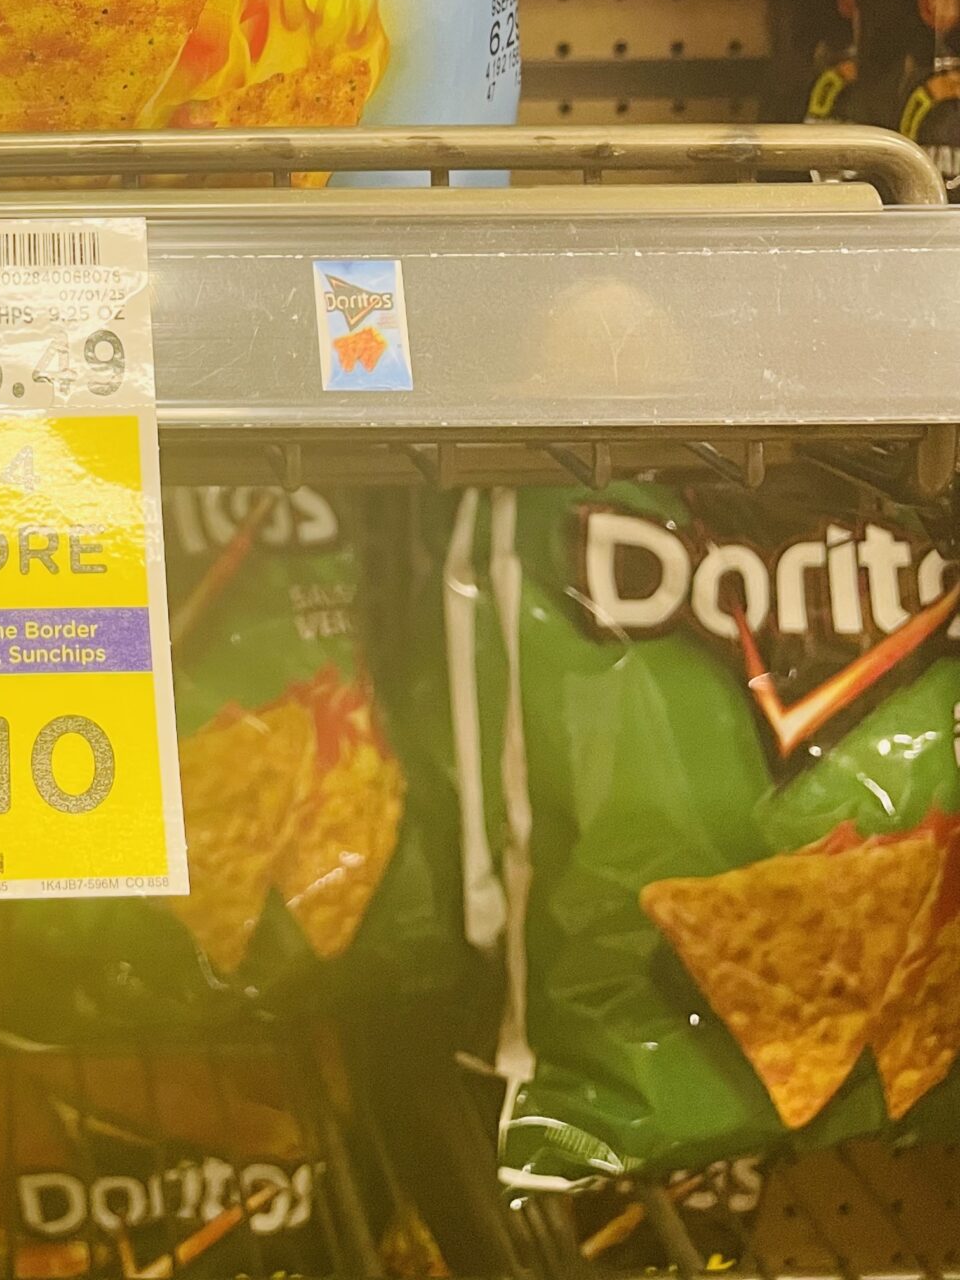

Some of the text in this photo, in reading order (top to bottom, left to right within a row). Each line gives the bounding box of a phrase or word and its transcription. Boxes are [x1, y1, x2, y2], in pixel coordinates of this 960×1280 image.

[325, 293, 392, 312] Doritos
[0, 445, 37, 493] 4
[586, 510, 960, 639] Dorit
[25, 620, 98, 640] Border
[8, 644, 106, 667] Sunchips
[125, 877, 144, 888] CO
